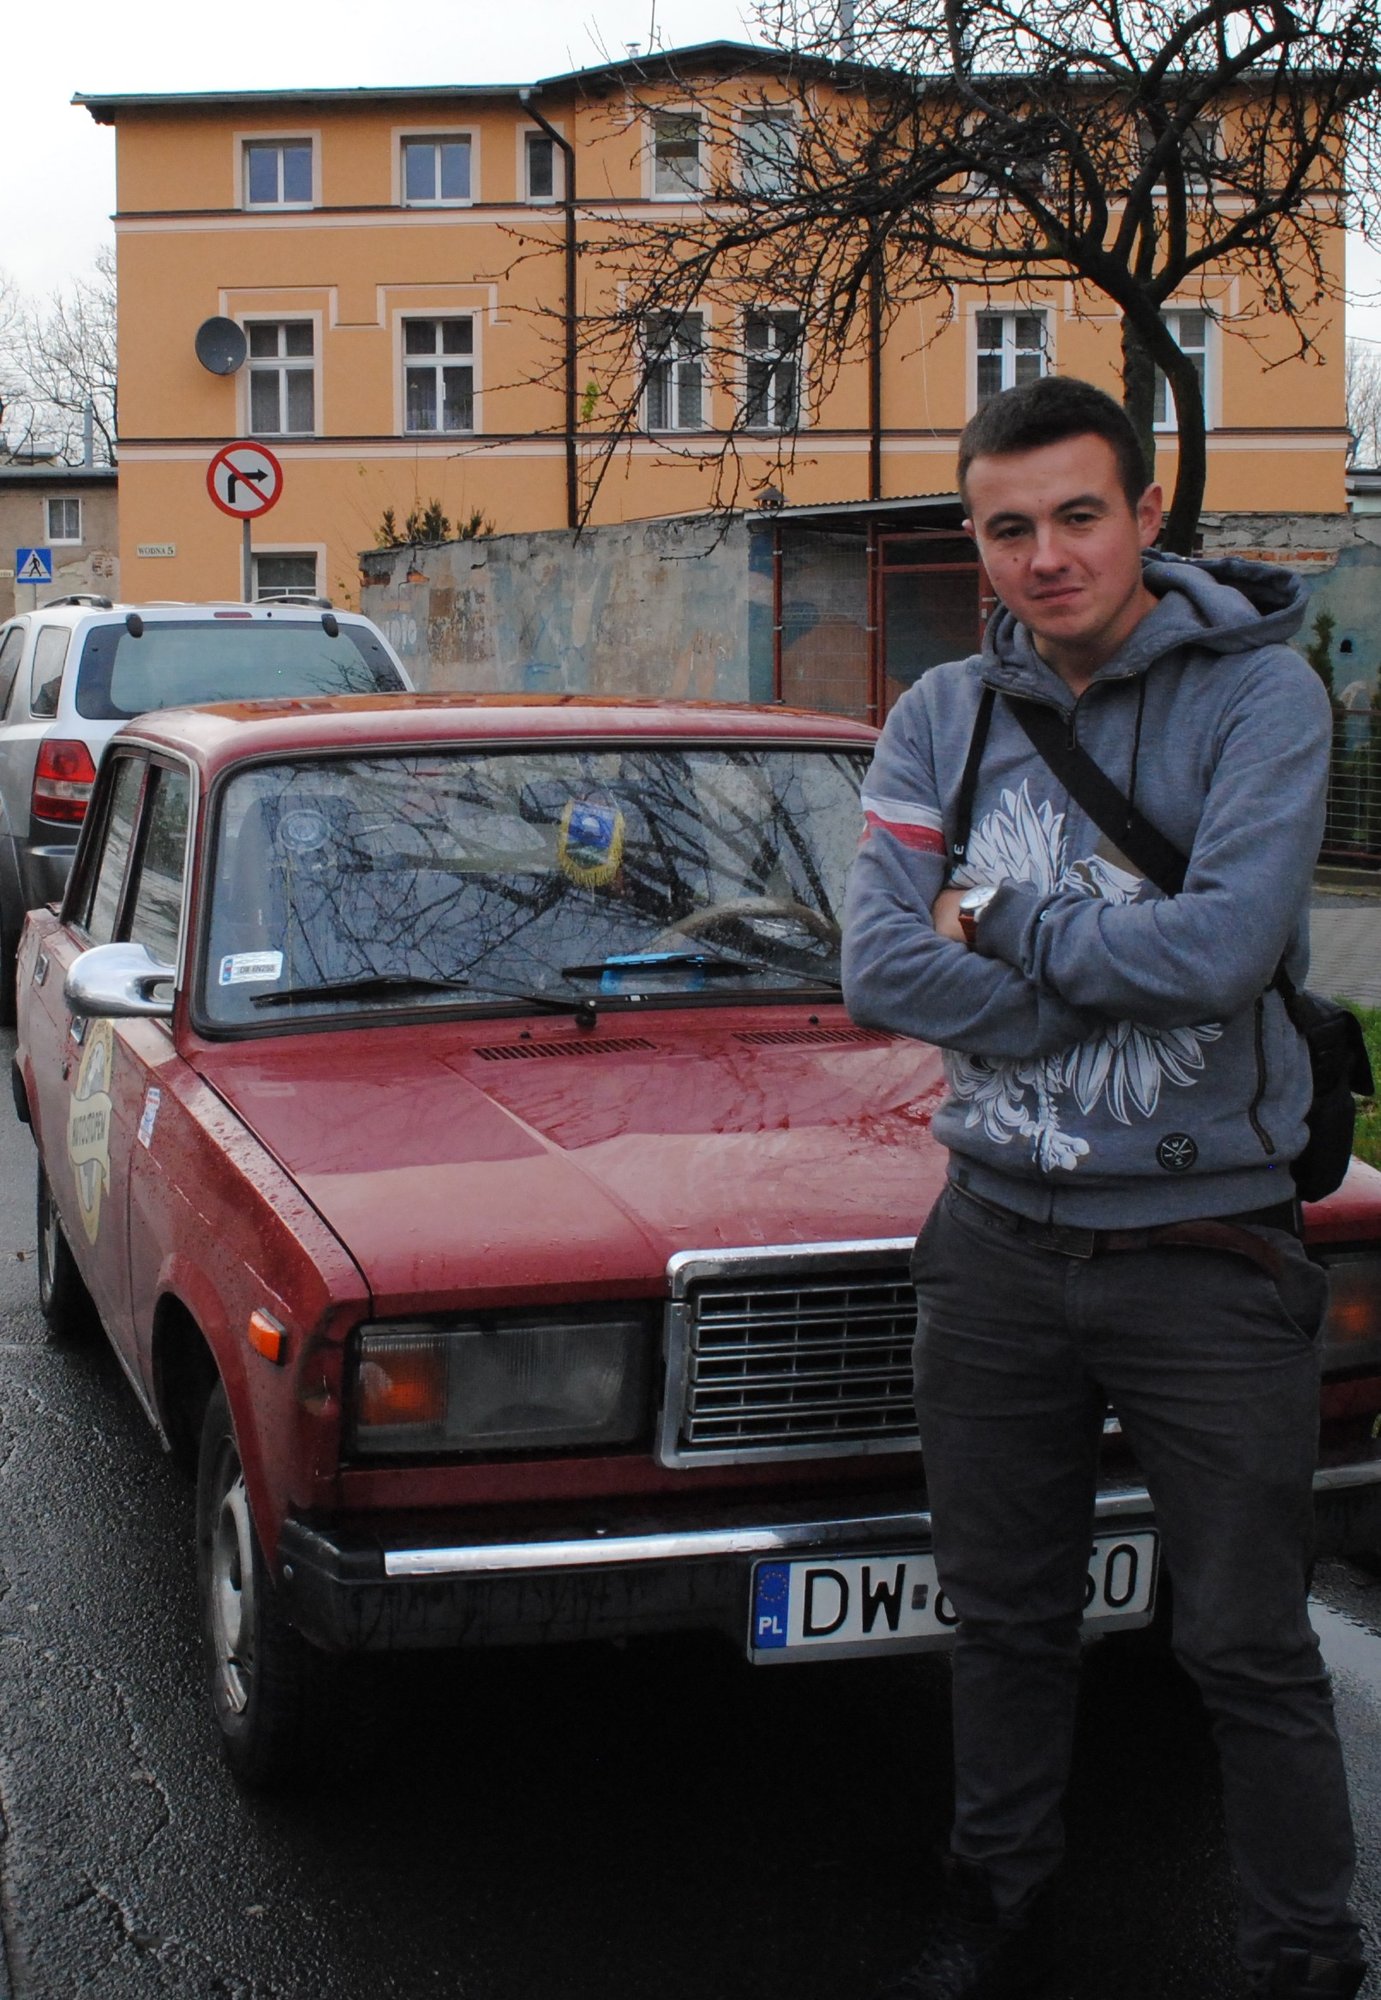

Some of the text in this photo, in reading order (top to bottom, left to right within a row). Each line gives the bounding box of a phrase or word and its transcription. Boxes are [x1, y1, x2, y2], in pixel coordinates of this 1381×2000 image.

[167, 545, 174, 556] 5
[802, 1563, 907, 1638] DW
[758, 1615, 783, 1635] PL
